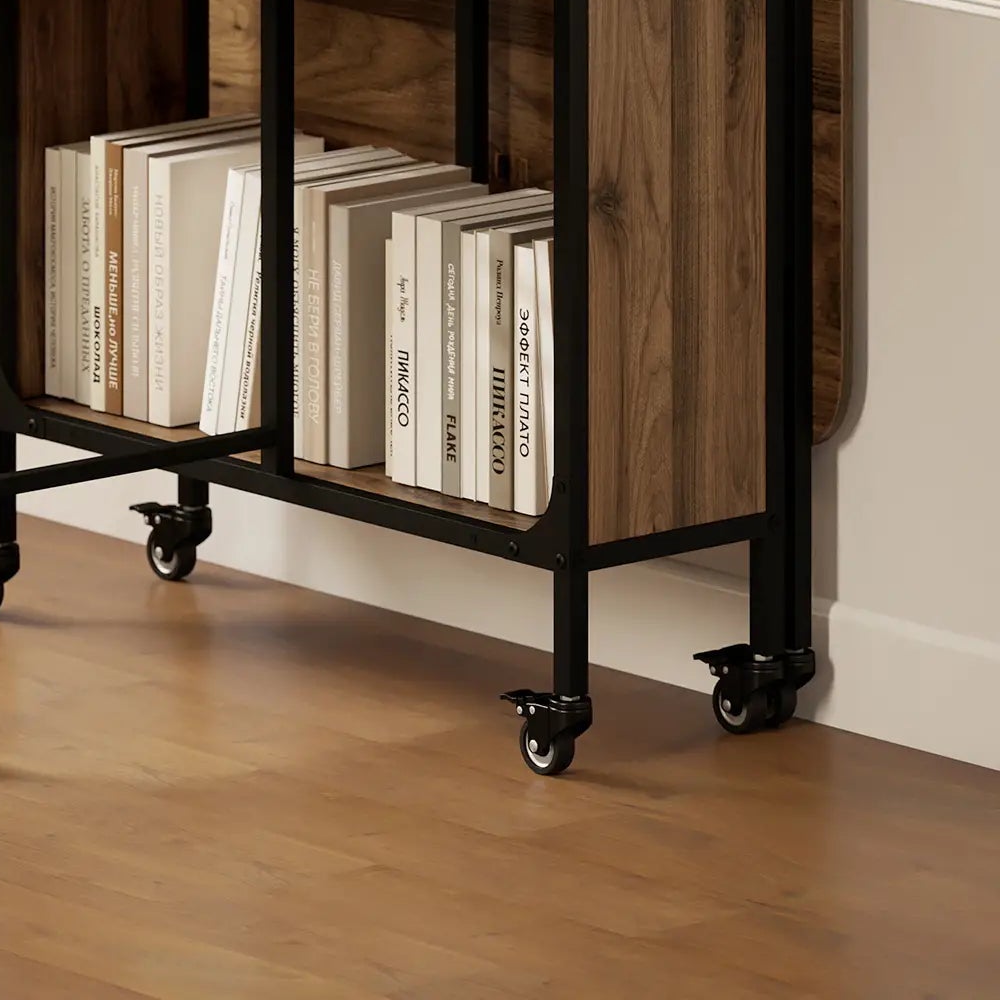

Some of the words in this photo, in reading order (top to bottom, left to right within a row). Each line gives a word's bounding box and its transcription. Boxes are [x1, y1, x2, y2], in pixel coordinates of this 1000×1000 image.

[82, 197, 91, 254] ЗАБОТА
[154, 194, 164, 257] НОВЫЙ
[82, 261, 91, 272] О
[154, 264, 164, 320] ОБРАЗ
[308, 269, 319, 290] НЕ
[446, 263, 455, 301] СЕГОДНЯ
[246, 318, 257, 360] черной
[308, 294, 319, 338] БЕРИ
[446, 303, 455, 327] ДЕНЬ
[93, 306, 101, 383] ШОКОЛАД
[108, 338, 118, 390] ЛУЧШЕ
[154, 326, 164, 392] ЖИЗНИ
[308, 342, 319, 353] В
[446, 330, 455, 374] РОЖДЕНИЯ
[519, 308, 530, 387] ЭФФЕКТ
[239, 360, 252, 420] водолазки
[308, 356, 319, 425] ГОЛОВУ
[397, 349, 409, 428] ПИКАССО
[446, 376, 455, 401] МИРА
[446, 415, 457, 462] FLAKE
[492, 367, 506, 475] ПИКАССО
[519, 392, 530, 458] ПЛАТО
